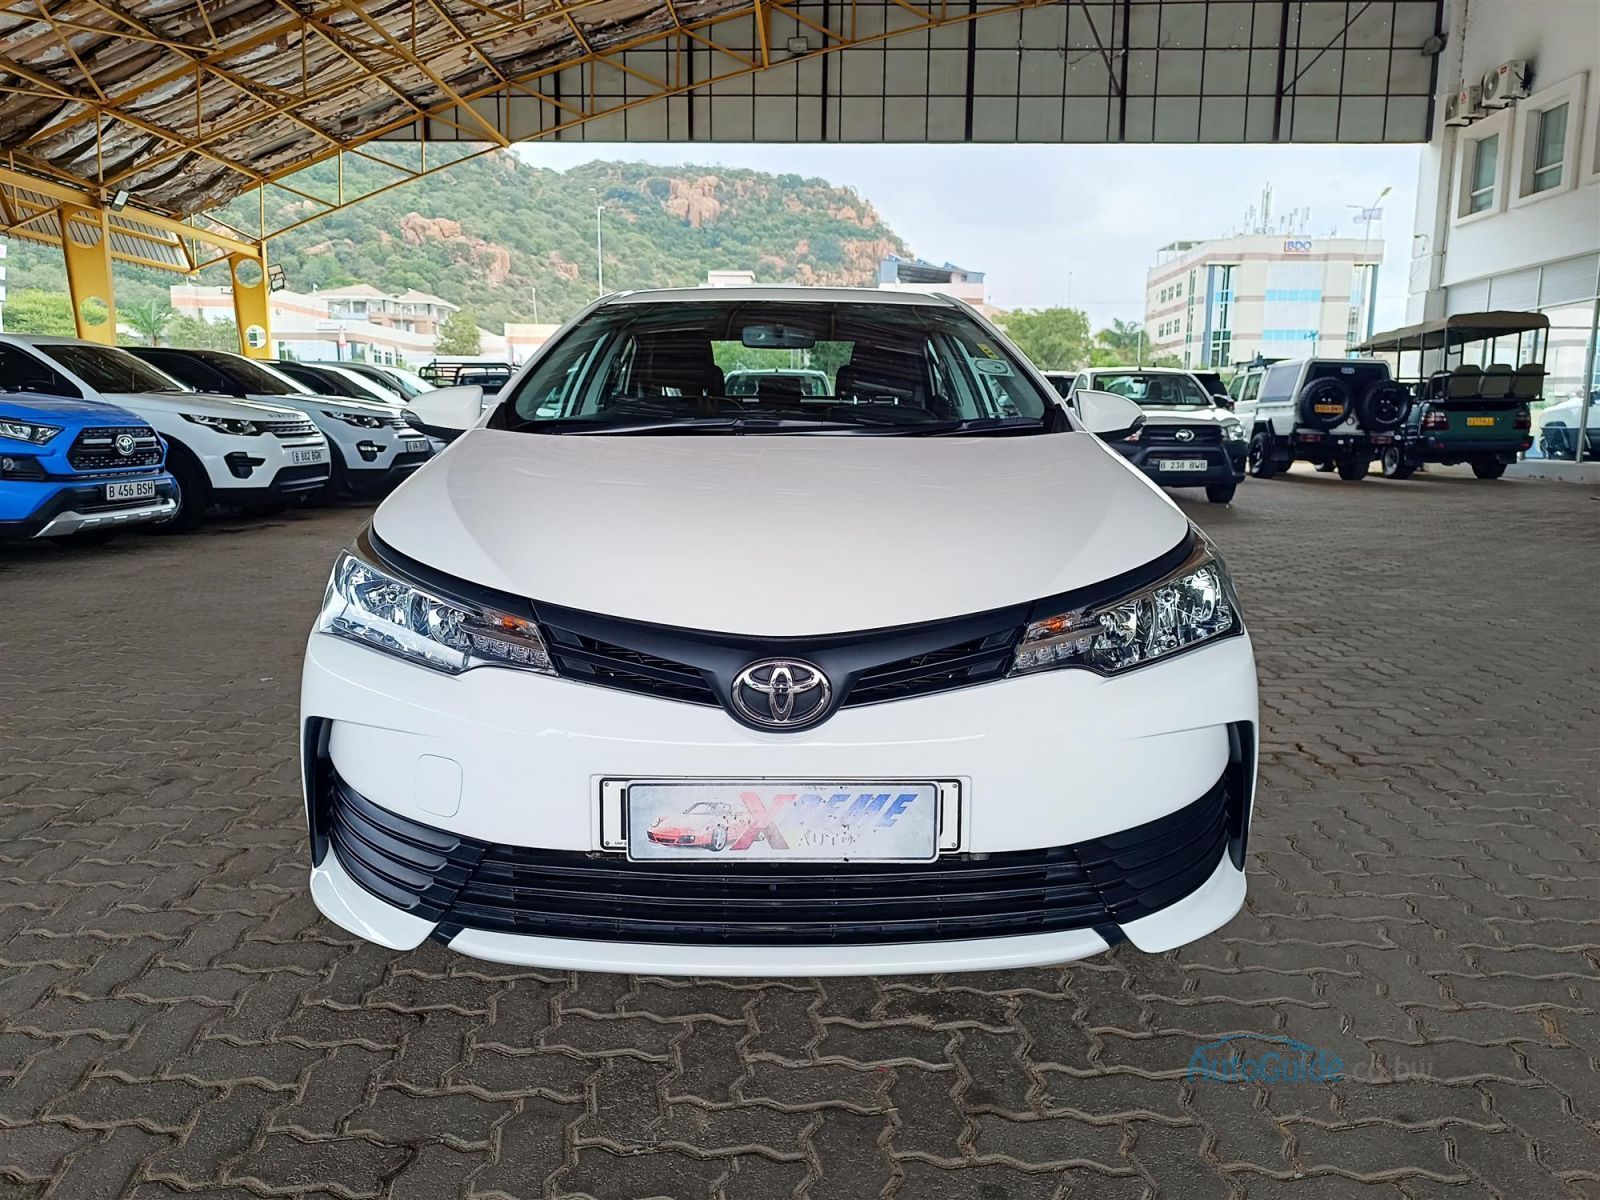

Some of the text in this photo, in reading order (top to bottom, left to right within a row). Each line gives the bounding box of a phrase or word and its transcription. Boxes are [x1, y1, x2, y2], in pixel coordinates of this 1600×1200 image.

[1286, 240, 1312, 251] BDO
[109, 482, 153, 498] B 456 BSH
